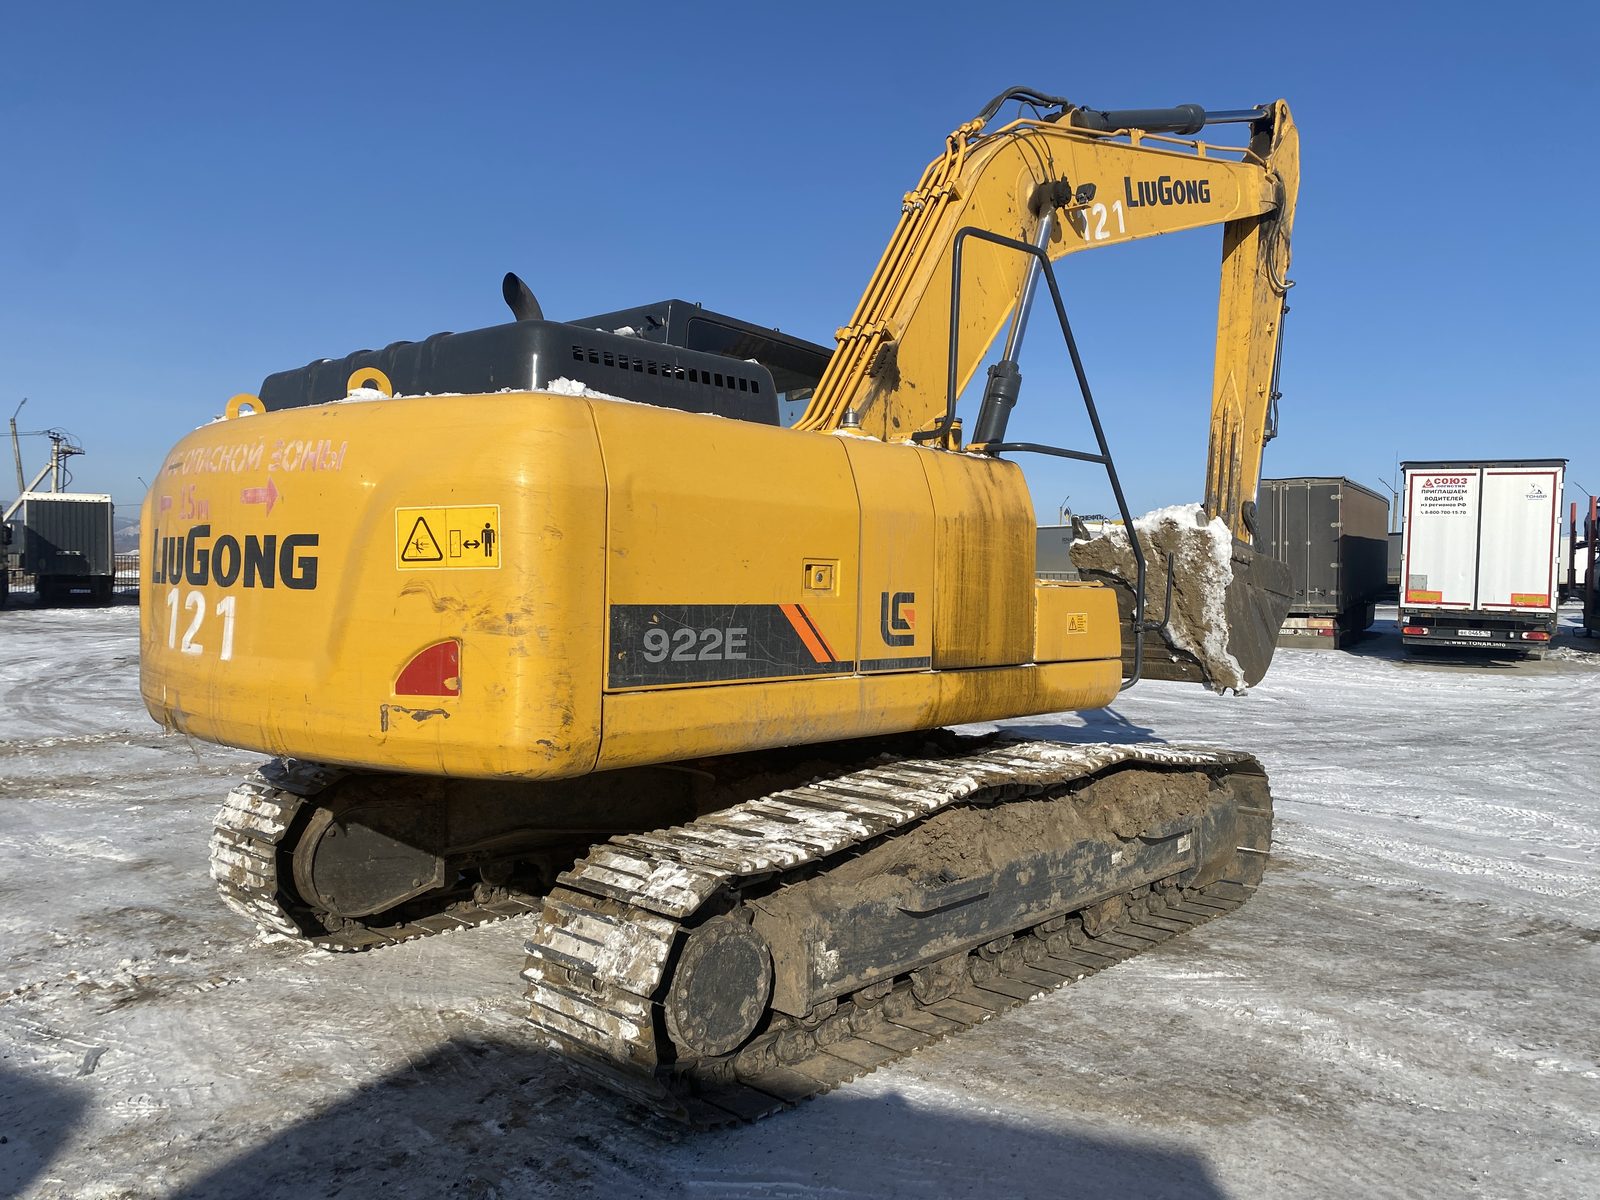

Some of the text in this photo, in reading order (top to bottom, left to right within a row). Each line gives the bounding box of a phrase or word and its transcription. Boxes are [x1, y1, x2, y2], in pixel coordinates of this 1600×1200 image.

[1080, 199, 1126, 241] 121
[267, 438, 349, 473] ЗОНЫ
[1433, 477, 1468, 485] СОЮЗ
[167, 587, 237, 662] 121
[643, 627, 748, 663] 922E
